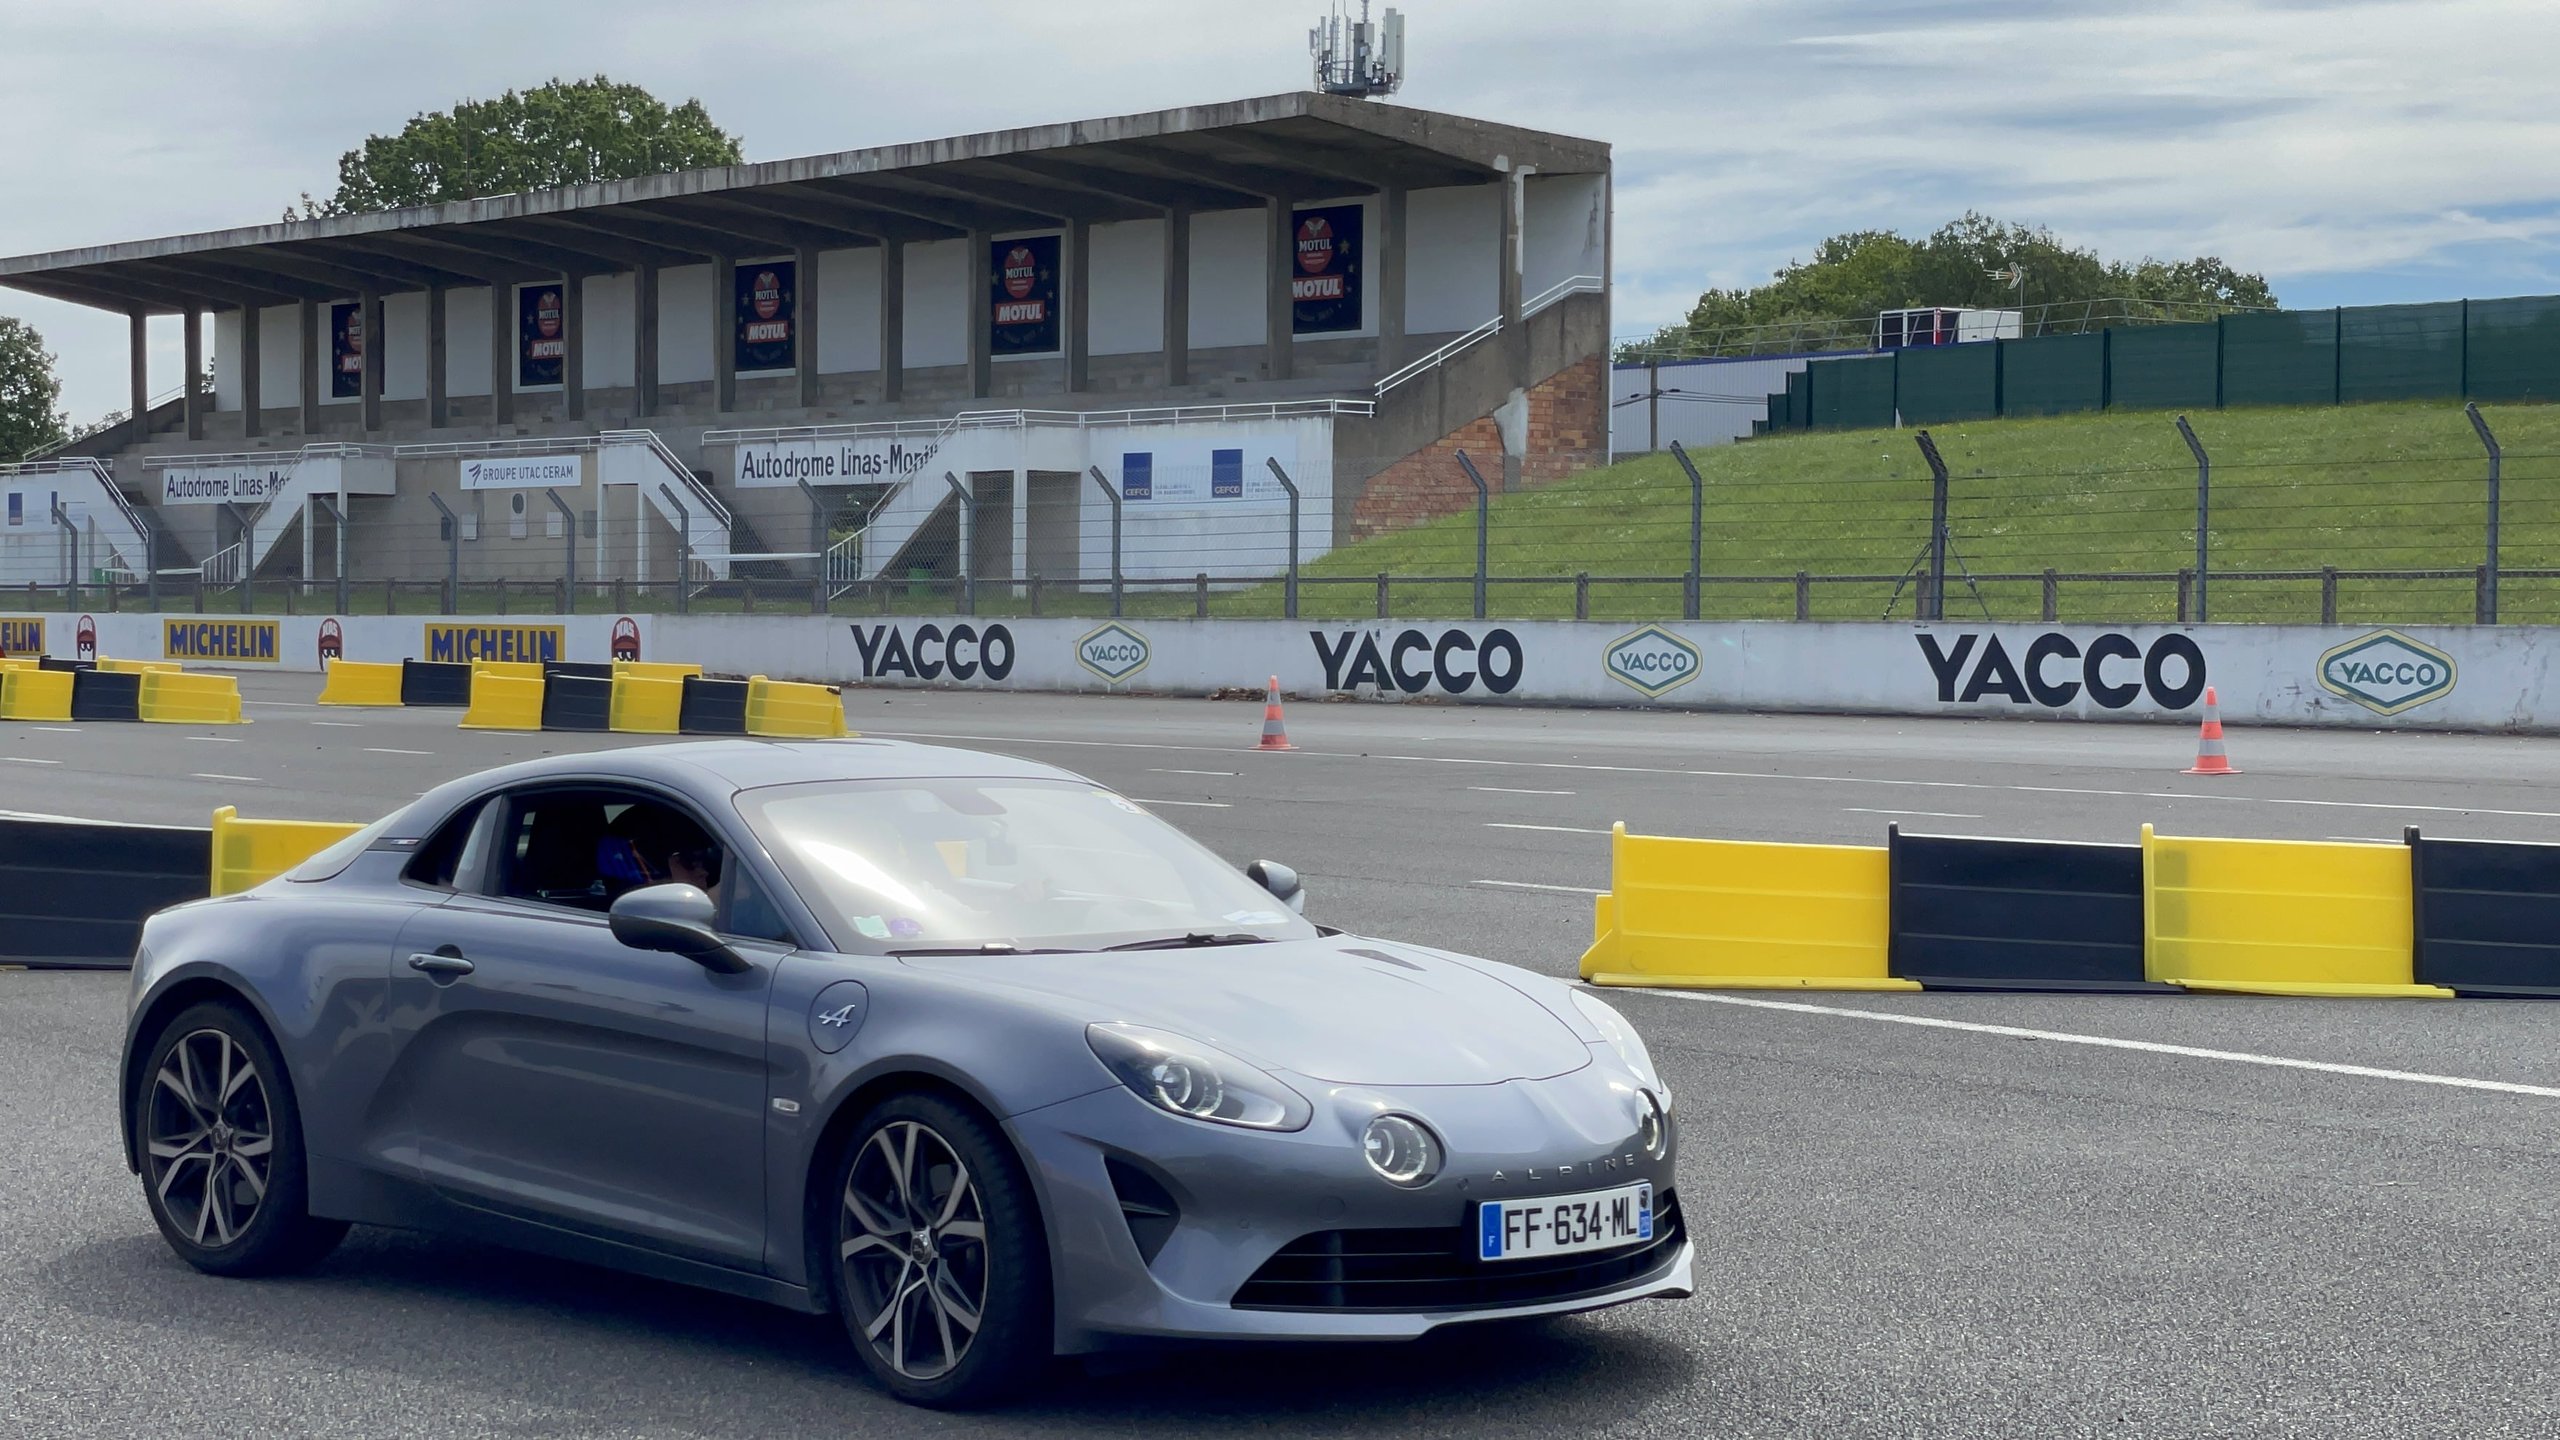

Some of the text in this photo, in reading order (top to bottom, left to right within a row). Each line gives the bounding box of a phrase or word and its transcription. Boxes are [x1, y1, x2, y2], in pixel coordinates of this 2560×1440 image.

[1299, 239, 1332, 252] MOTUL
[1006, 266, 1034, 279] MOTUL
[1292, 279, 1341, 298] MOTUL
[998, 303, 1042, 321] MOTUL
[748, 323, 786, 340] MOTUL
[483, 465, 573, 481] GROUPE UTAC CERAM
[741, 449, 835, 479] Autodrome
[166, 474, 229, 498] Autodrome
[2, 622, 41, 651] ELIN
[170, 624, 274, 658] MICHELIN
[431, 628, 557, 663] MICHELIN
[850, 624, 1015, 681] YACCO
[1088, 645, 1140, 662] YACCO
[1309, 628, 1523, 694] YACCO
[1619, 652, 1688, 672] YACCO
[1915, 632, 2207, 710] YACCO
[2338, 662, 2436, 686] YACCO
[1491, 1153, 1635, 1182] ALPINE
